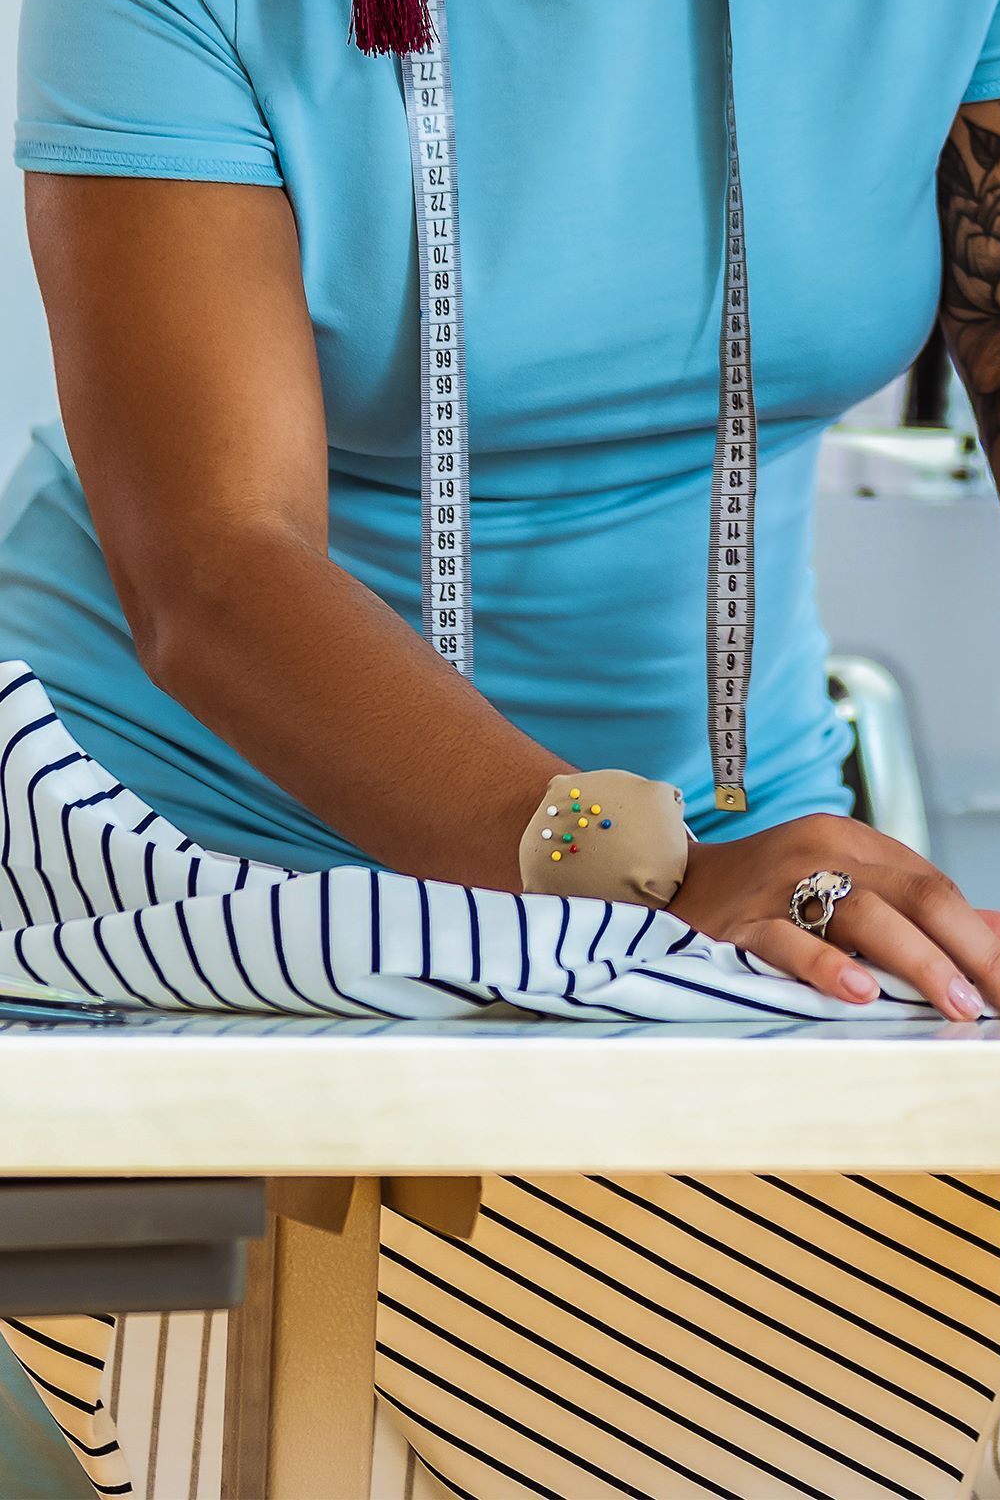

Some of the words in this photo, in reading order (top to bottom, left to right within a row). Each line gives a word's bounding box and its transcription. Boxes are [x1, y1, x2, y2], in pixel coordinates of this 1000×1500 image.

[419, 63, 437, 82] 77
[421, 88, 439, 108] 76
[423, 116, 441, 134] 75
[426, 141, 443, 160] 74
[429, 167, 445, 186] 73
[430, 193, 447, 212] 72
[433, 220, 448, 238] 71
[433, 246, 450, 264] 70
[434, 272, 450, 291] 69
[435, 298, 450, 317] 68
[732, 316, 741, 332] 19
[436, 324, 451, 343] 67
[731, 342, 741, 358] 18
[436, 350, 452, 369] 66
[732, 368, 742, 384] 17
[437, 376, 453, 395] 65
[732, 393, 744, 410] 16
[437, 402, 453, 421] 64
[732, 419, 745, 436] 15
[438, 428, 453, 447] 63
[731, 445, 744, 462] 14
[438, 454, 454, 473] 62
[729, 471, 742, 487] 13
[439, 480, 454, 499] 61
[728, 497, 741, 513] 12
[438, 507, 455, 525] 60
[728, 523, 740, 540] 11
[438, 532, 455, 550] 59
[726, 549, 740, 565] 10
[438, 558, 456, 577] 58
[439, 583, 456, 602] 57
[728, 575, 736, 592] 9
[728, 601, 736, 618] 8
[439, 610, 457, 629] 56
[728, 627, 736, 644] 7
[440, 636, 457, 654] 55
[727, 654, 735, 670] 6
[726, 680, 734, 696] 5
[725, 706, 733, 723] 4
[725, 732, 733, 749] 3
[726, 759, 733, 775] 2
